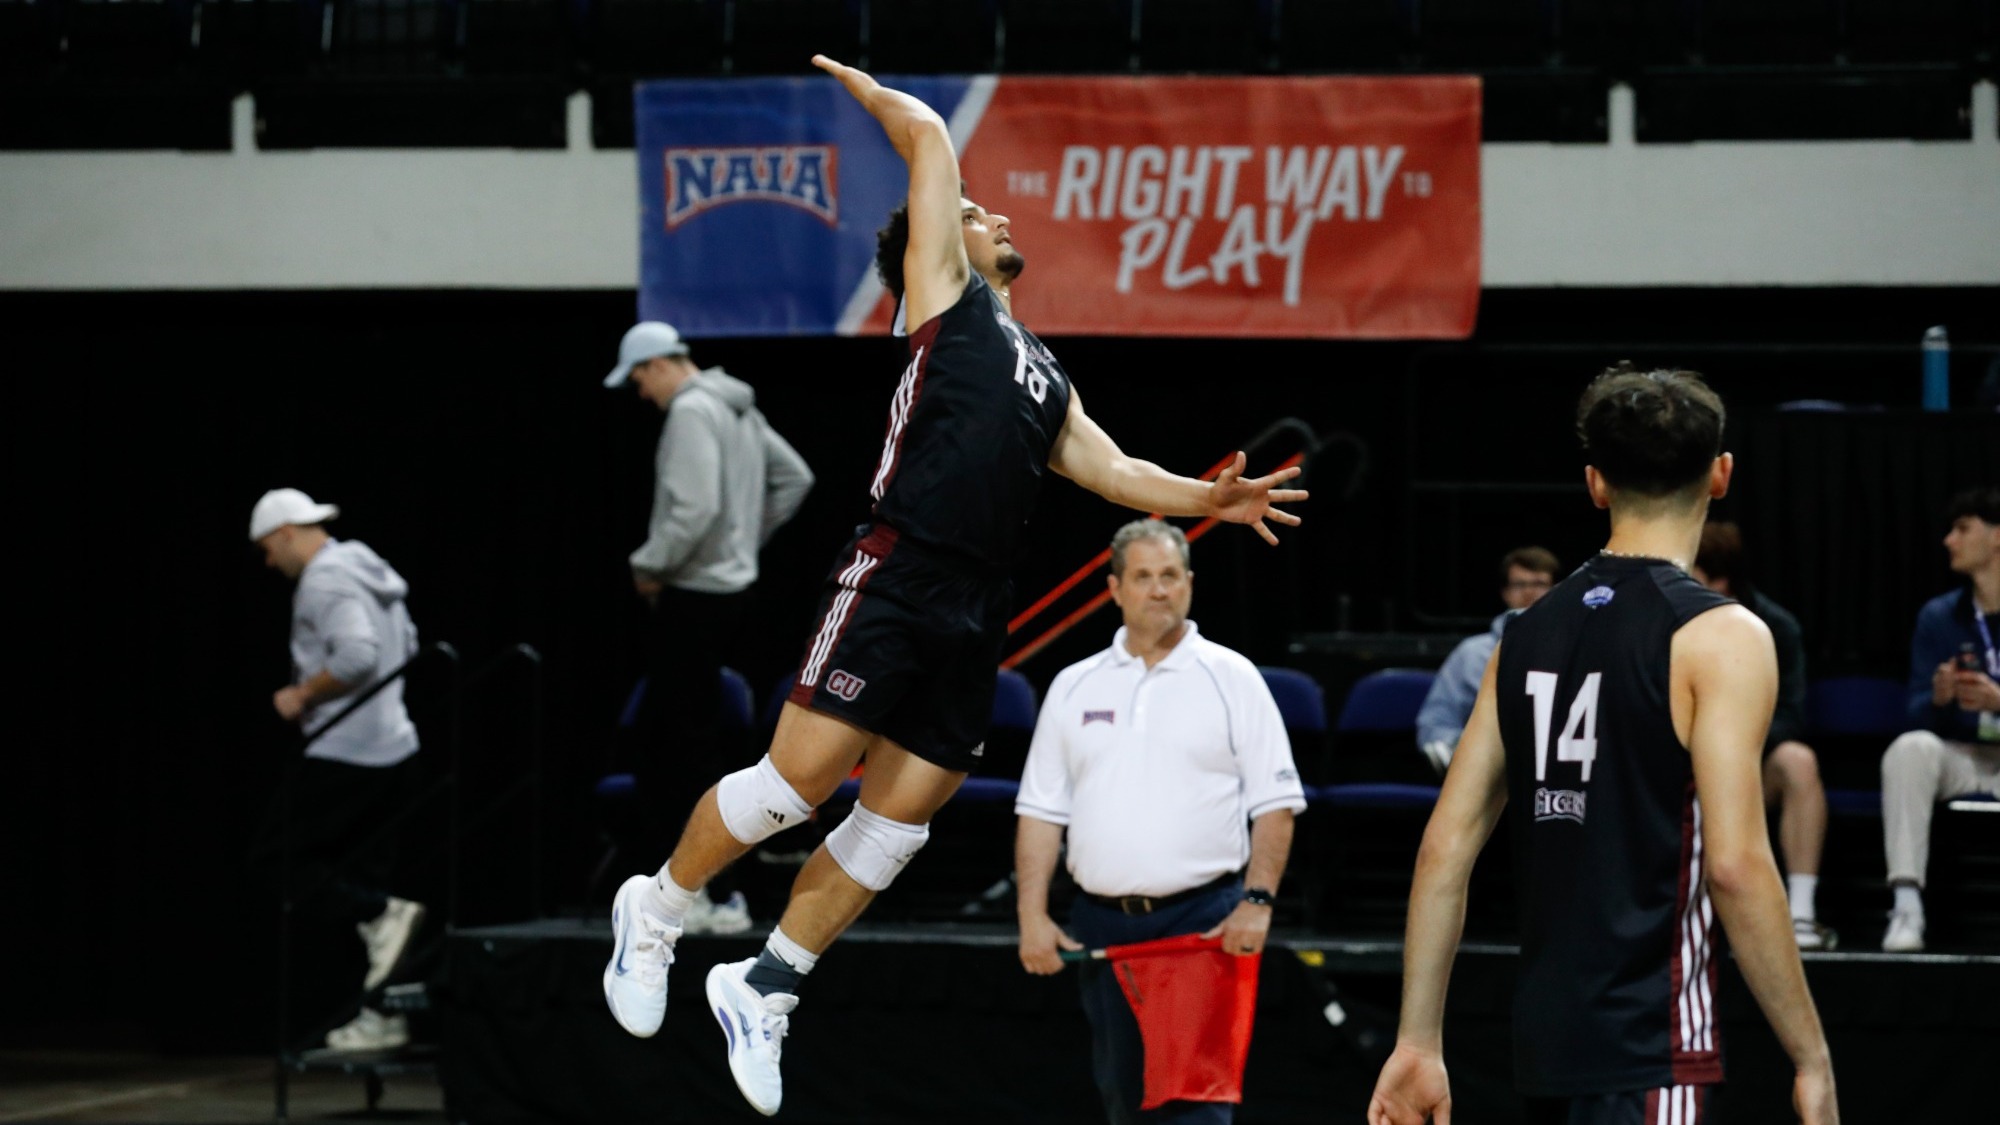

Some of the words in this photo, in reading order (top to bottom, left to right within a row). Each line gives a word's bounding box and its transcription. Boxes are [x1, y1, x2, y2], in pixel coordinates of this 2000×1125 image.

[667, 148, 836, 229] NAIA
[1006, 171, 1048, 196] THE
[1052, 145, 1252, 220] RIGHT
[1264, 145, 1404, 221] WAY
[1403, 172, 1433, 197] TO
[1115, 204, 1318, 307] PLAY
[826, 669, 866, 701] CU
[1525, 670, 1602, 782] 14
